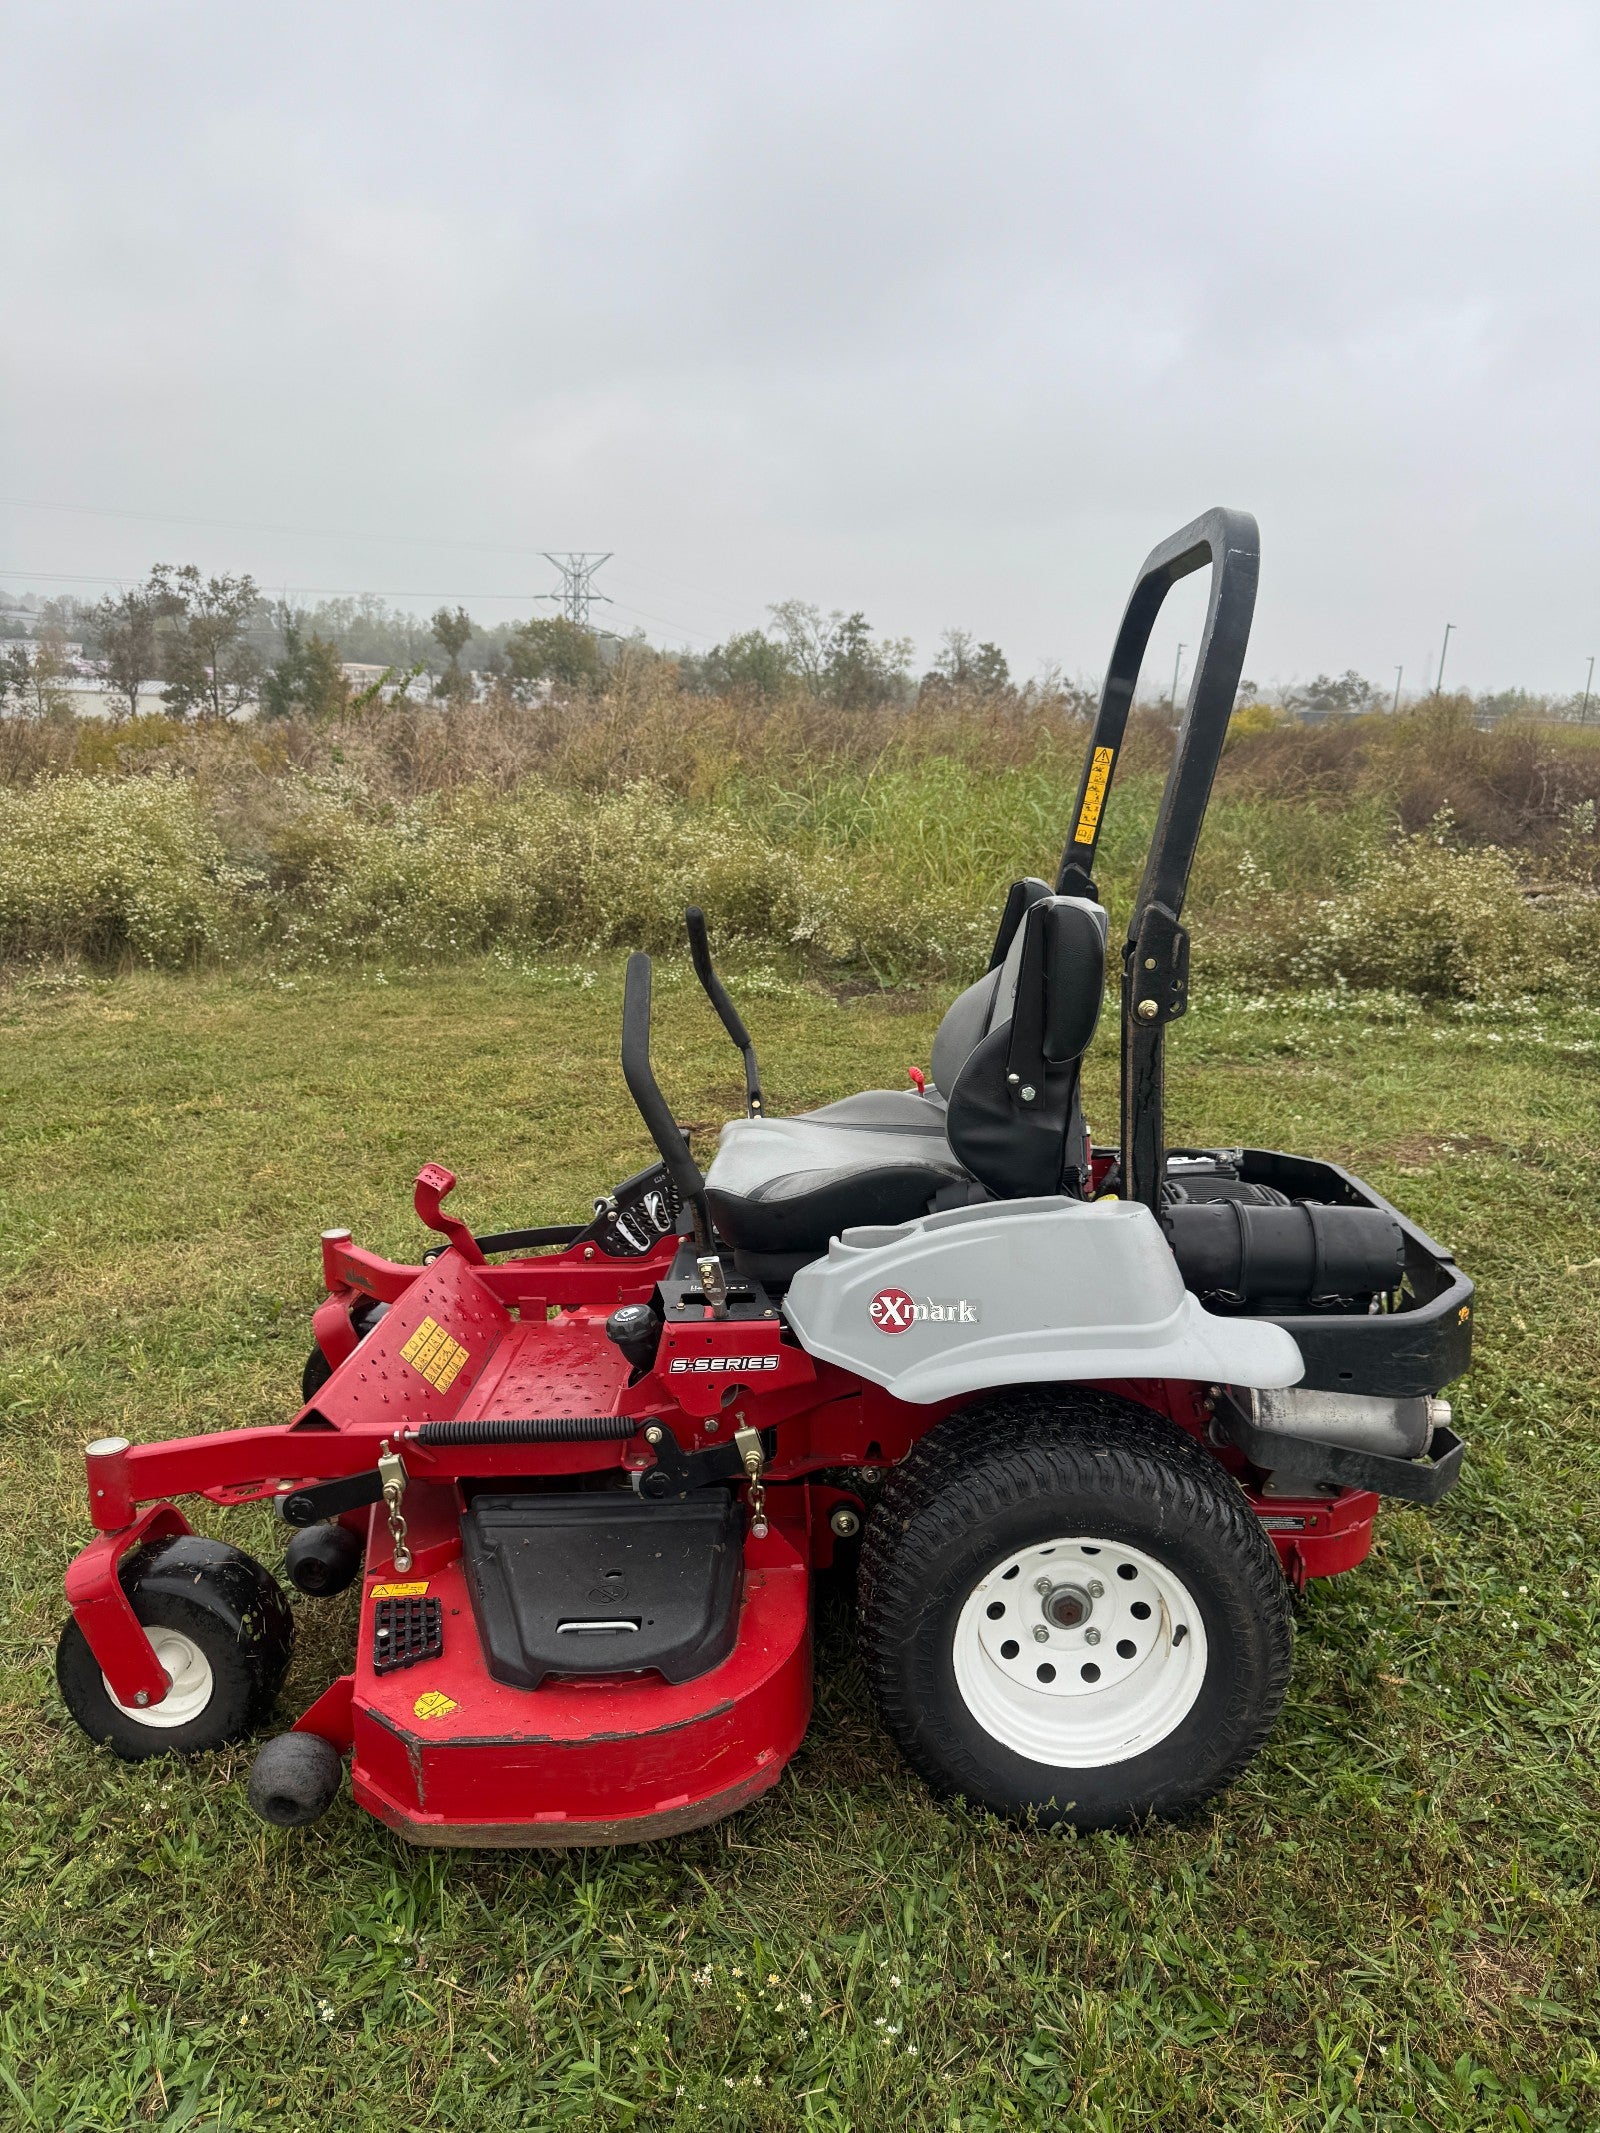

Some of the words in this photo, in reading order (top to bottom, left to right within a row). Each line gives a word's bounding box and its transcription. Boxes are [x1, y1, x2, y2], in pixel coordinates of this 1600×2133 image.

[670, 1356, 779, 1373] S-SERIES
[914, 1531, 1000, 1696] MASTER
[915, 1703, 997, 1793] TURF
